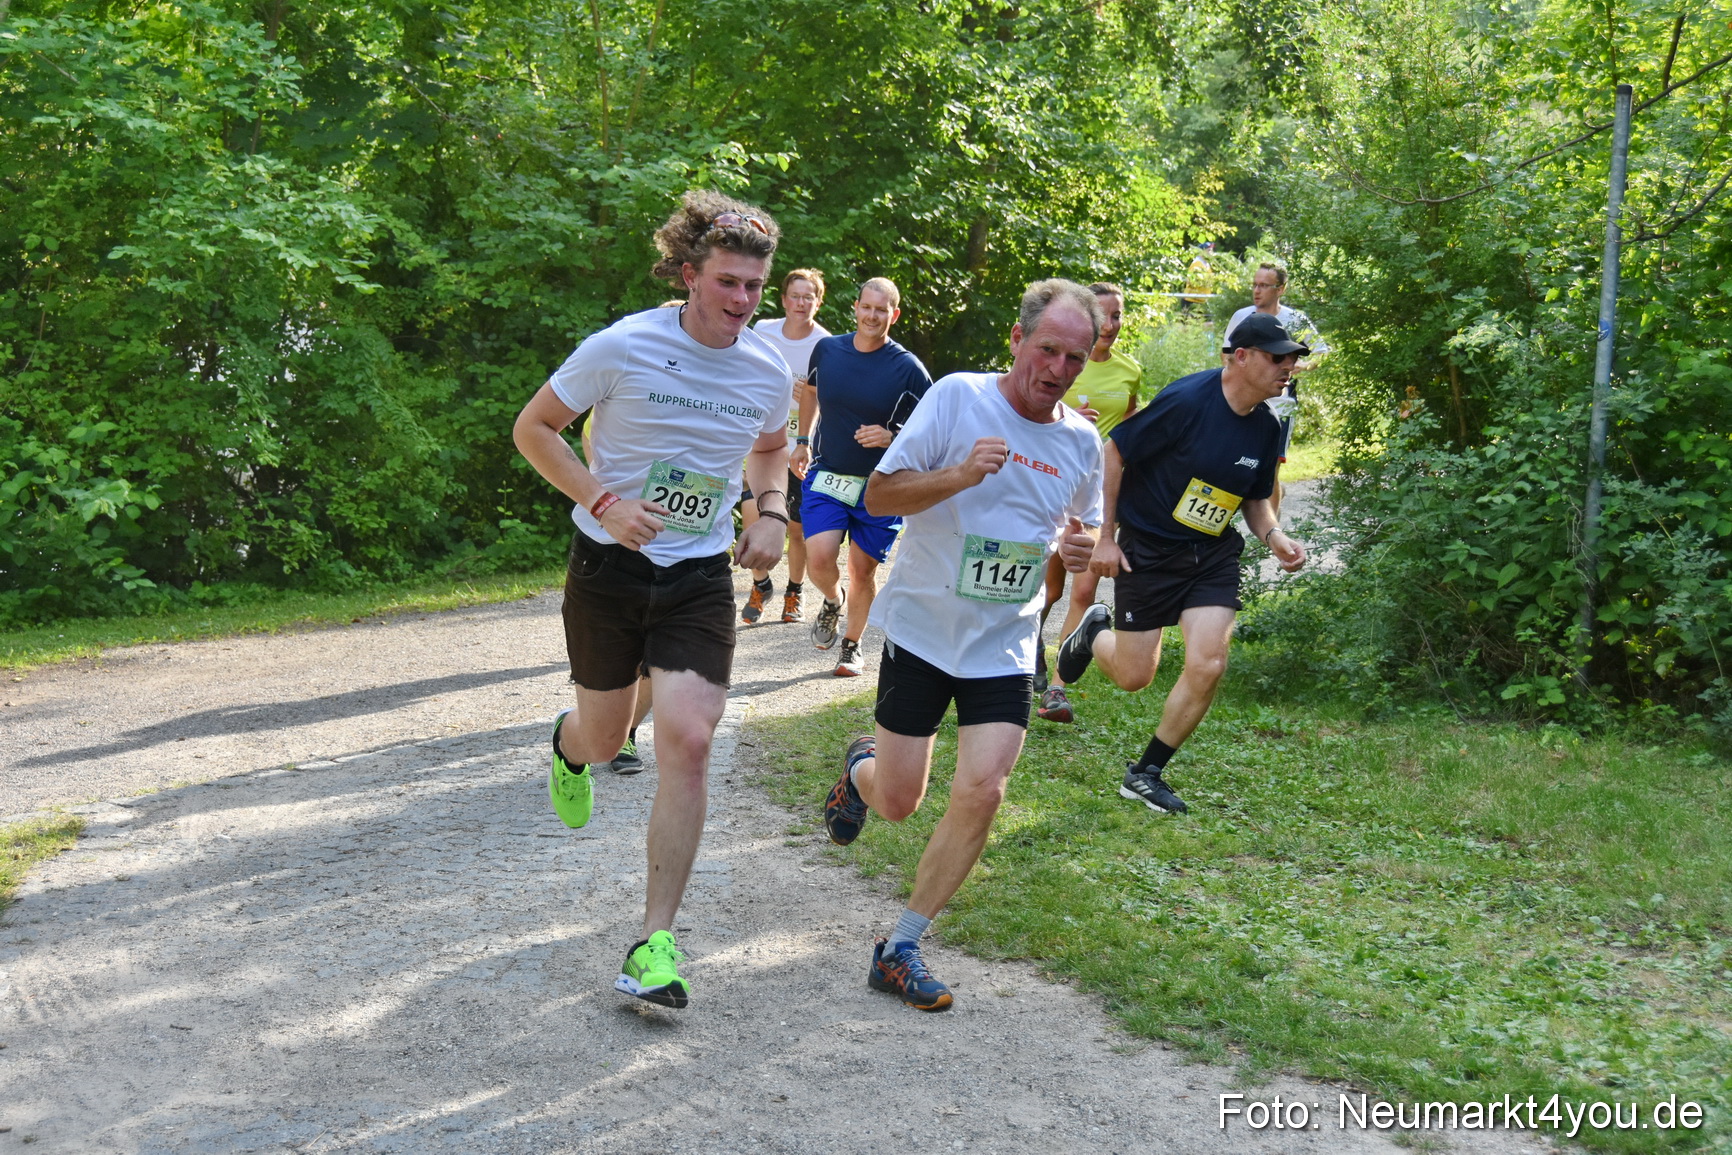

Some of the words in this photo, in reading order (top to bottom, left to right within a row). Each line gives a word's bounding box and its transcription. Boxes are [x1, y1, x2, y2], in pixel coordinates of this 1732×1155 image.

[648, 392, 714, 411] RUPPRECHT
[720, 404, 762, 420] HOLZBAU
[1013, 452, 1062, 479] KLEBL
[824, 474, 852, 491] 817
[652, 486, 712, 519] 2093
[1188, 497, 1227, 524] 1413
[972, 560, 1032, 587] 1147
[974, 583, 1002, 592] Blomeier
